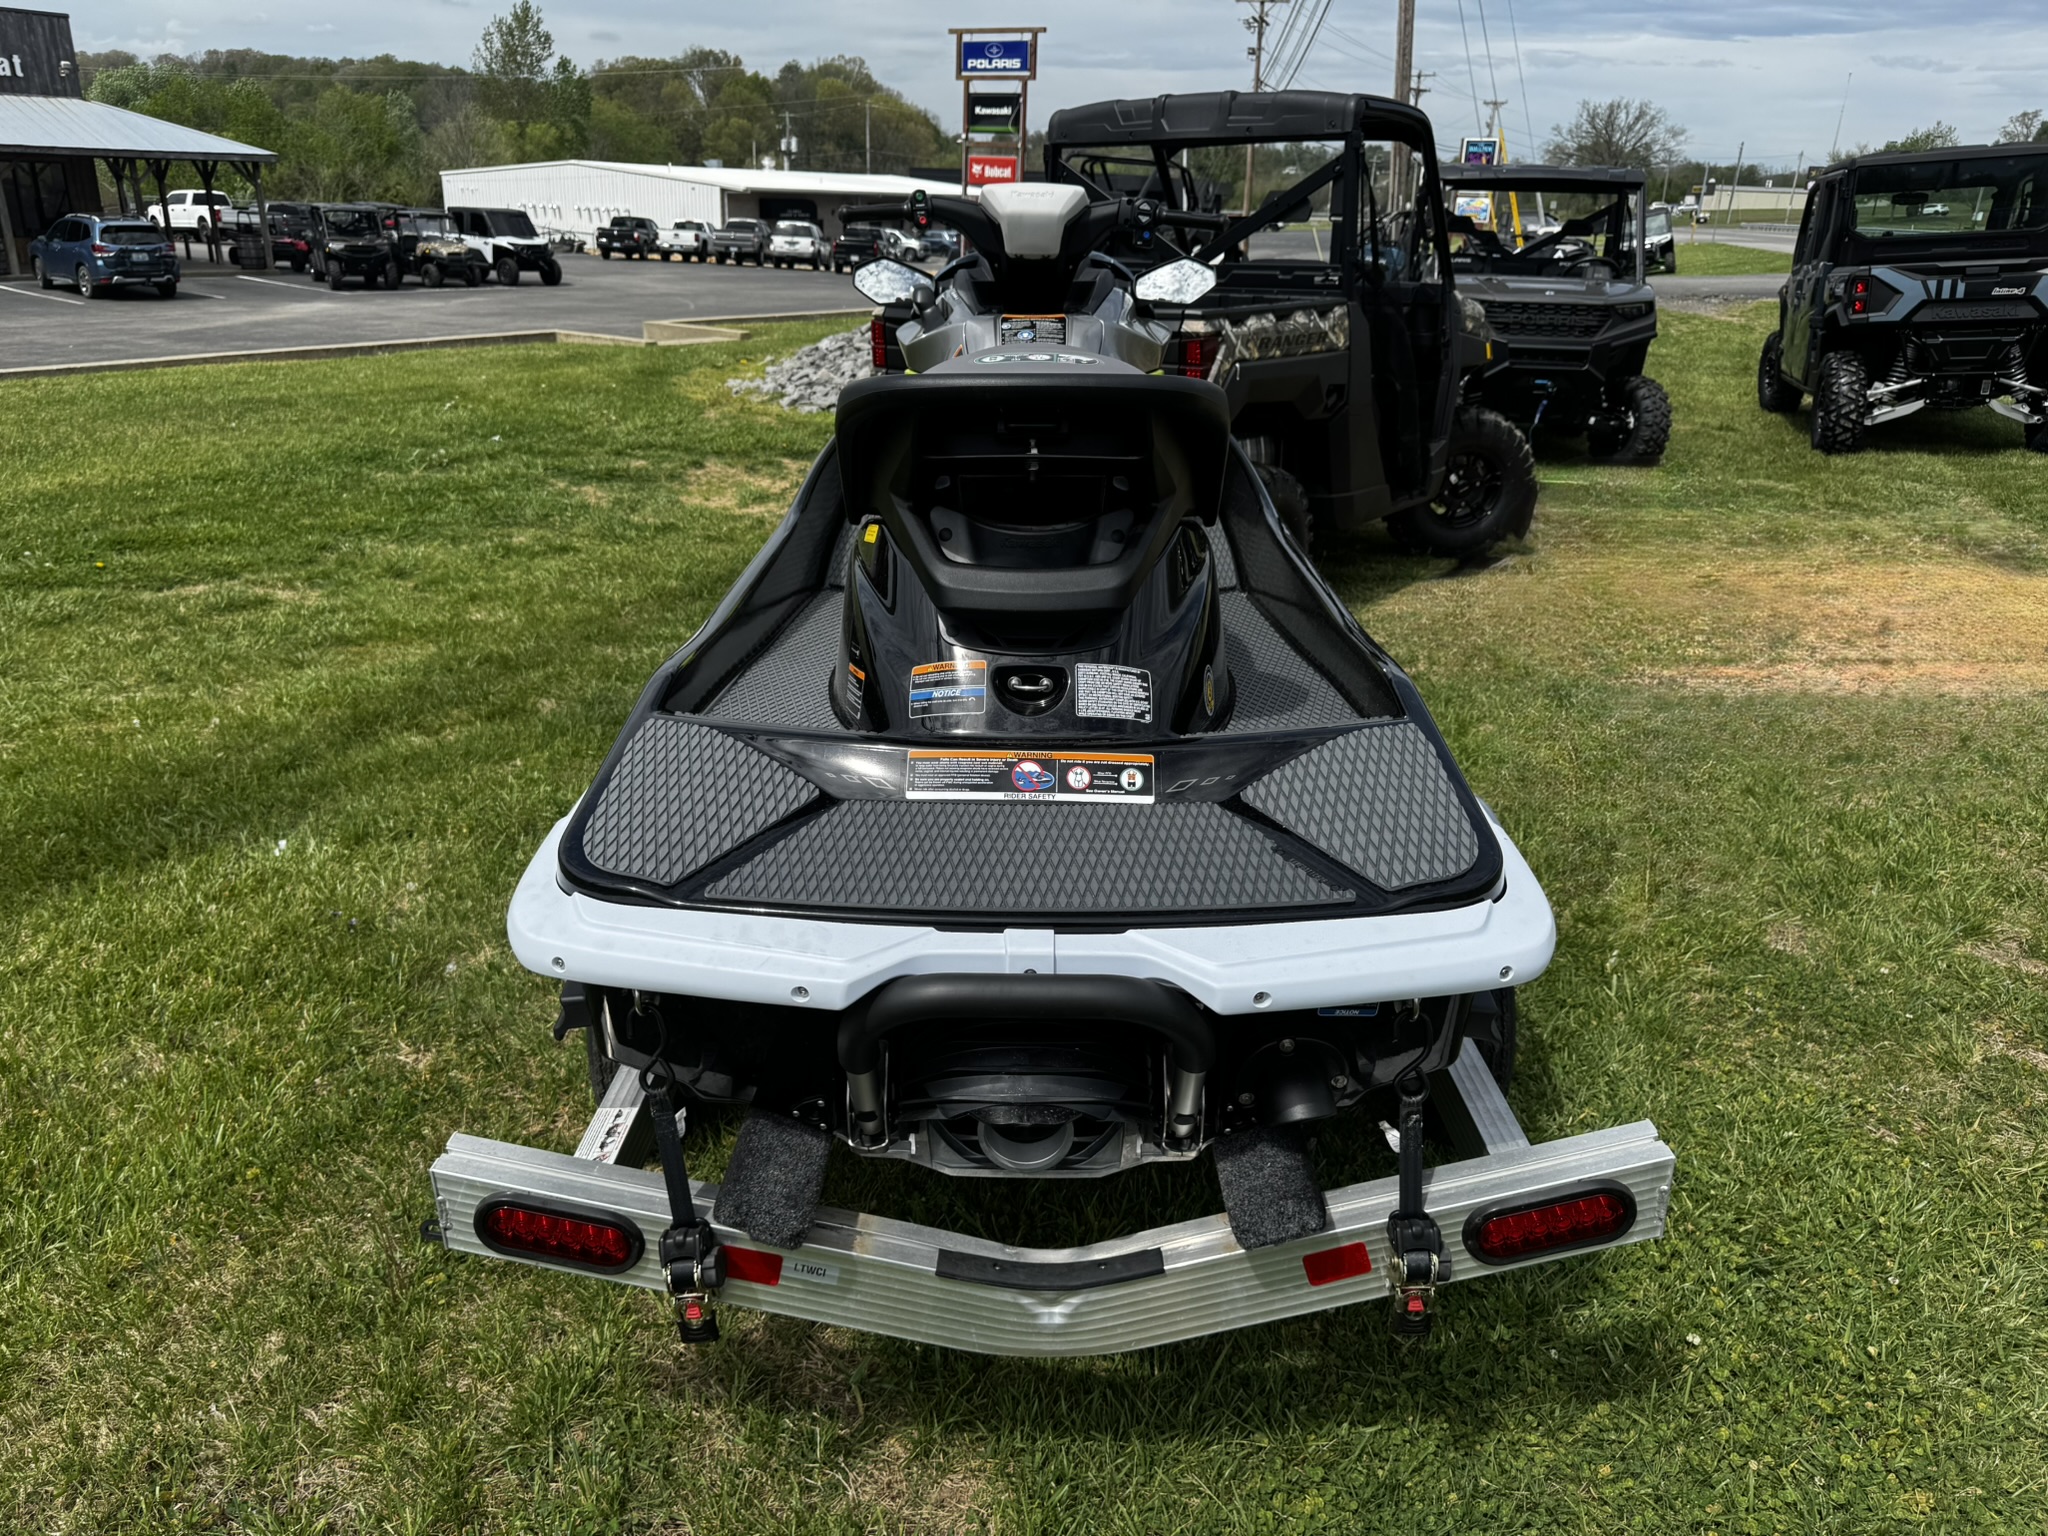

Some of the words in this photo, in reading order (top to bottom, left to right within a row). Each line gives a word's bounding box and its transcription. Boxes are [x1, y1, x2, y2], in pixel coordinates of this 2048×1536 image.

[967, 58, 1021, 69] POLARIS
[975, 105, 1012, 115] Kawasaki
[984, 165, 1012, 178] Bobcat
[1931, 303, 2020, 319] Kawasaki
[1511, 314, 1586, 325] POLARIS
[1257, 331, 1329, 350] RANGER
[932, 662, 969, 670] WARN
[932, 689, 962, 698] NOTICE
[793, 1262, 827, 1277] LTWCI
